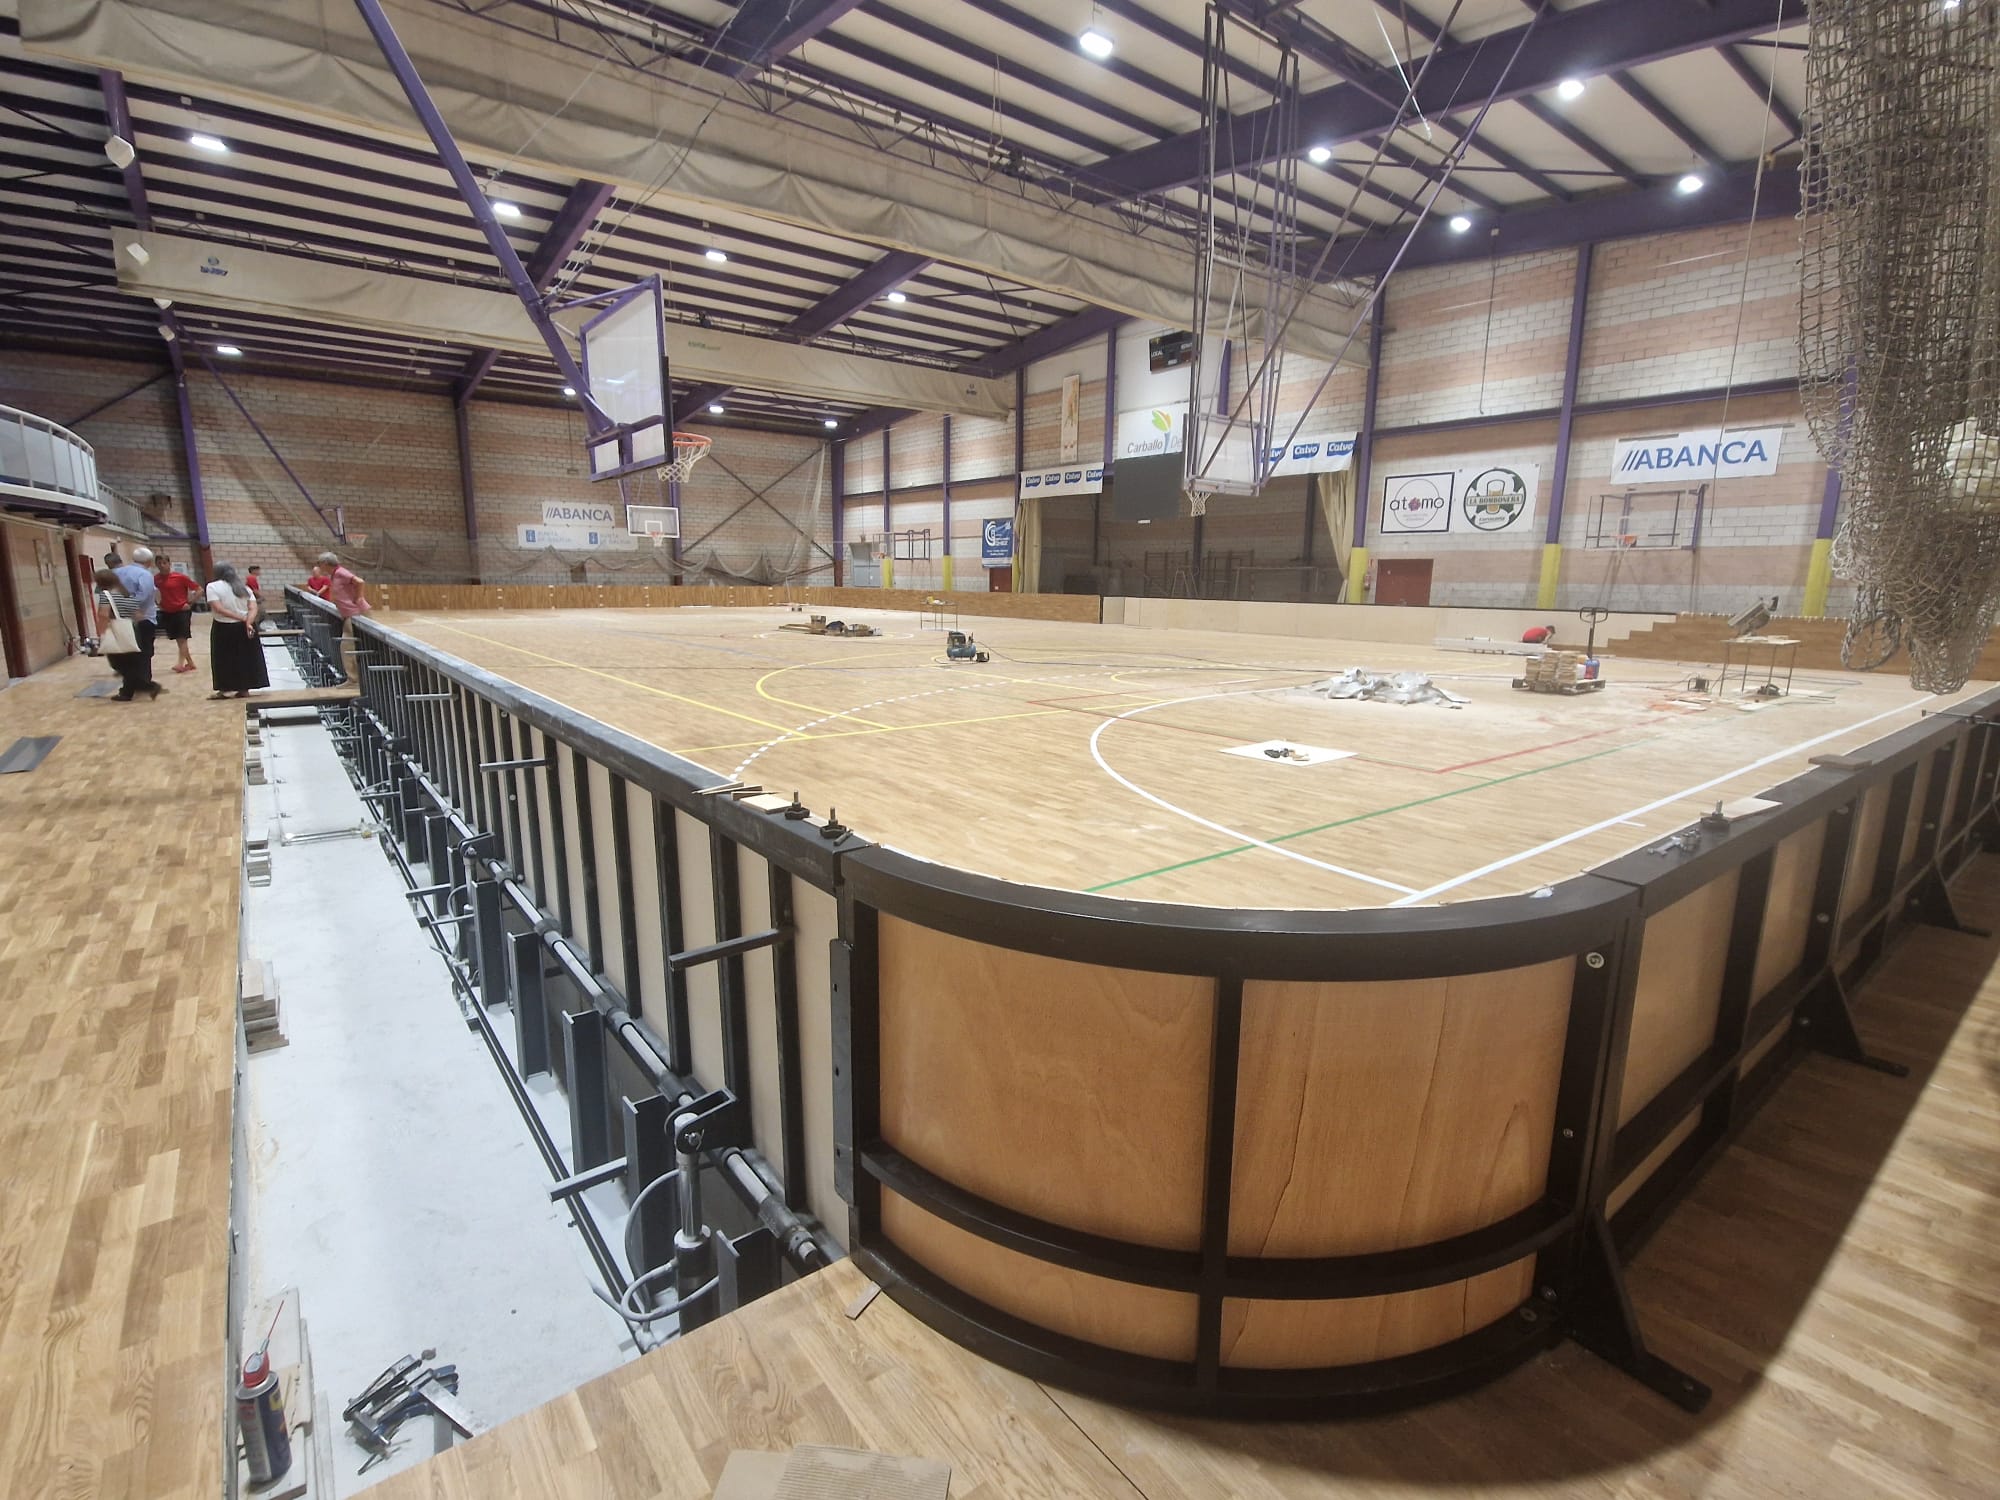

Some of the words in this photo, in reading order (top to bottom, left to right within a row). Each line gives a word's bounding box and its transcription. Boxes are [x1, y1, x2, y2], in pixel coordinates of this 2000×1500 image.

[1127, 439, 1163, 454] Carballo
[1294, 445, 1318, 455] Calvo
[1328, 441, 1354, 452] Calvo
[1087, 470, 1103, 478] Calvo
